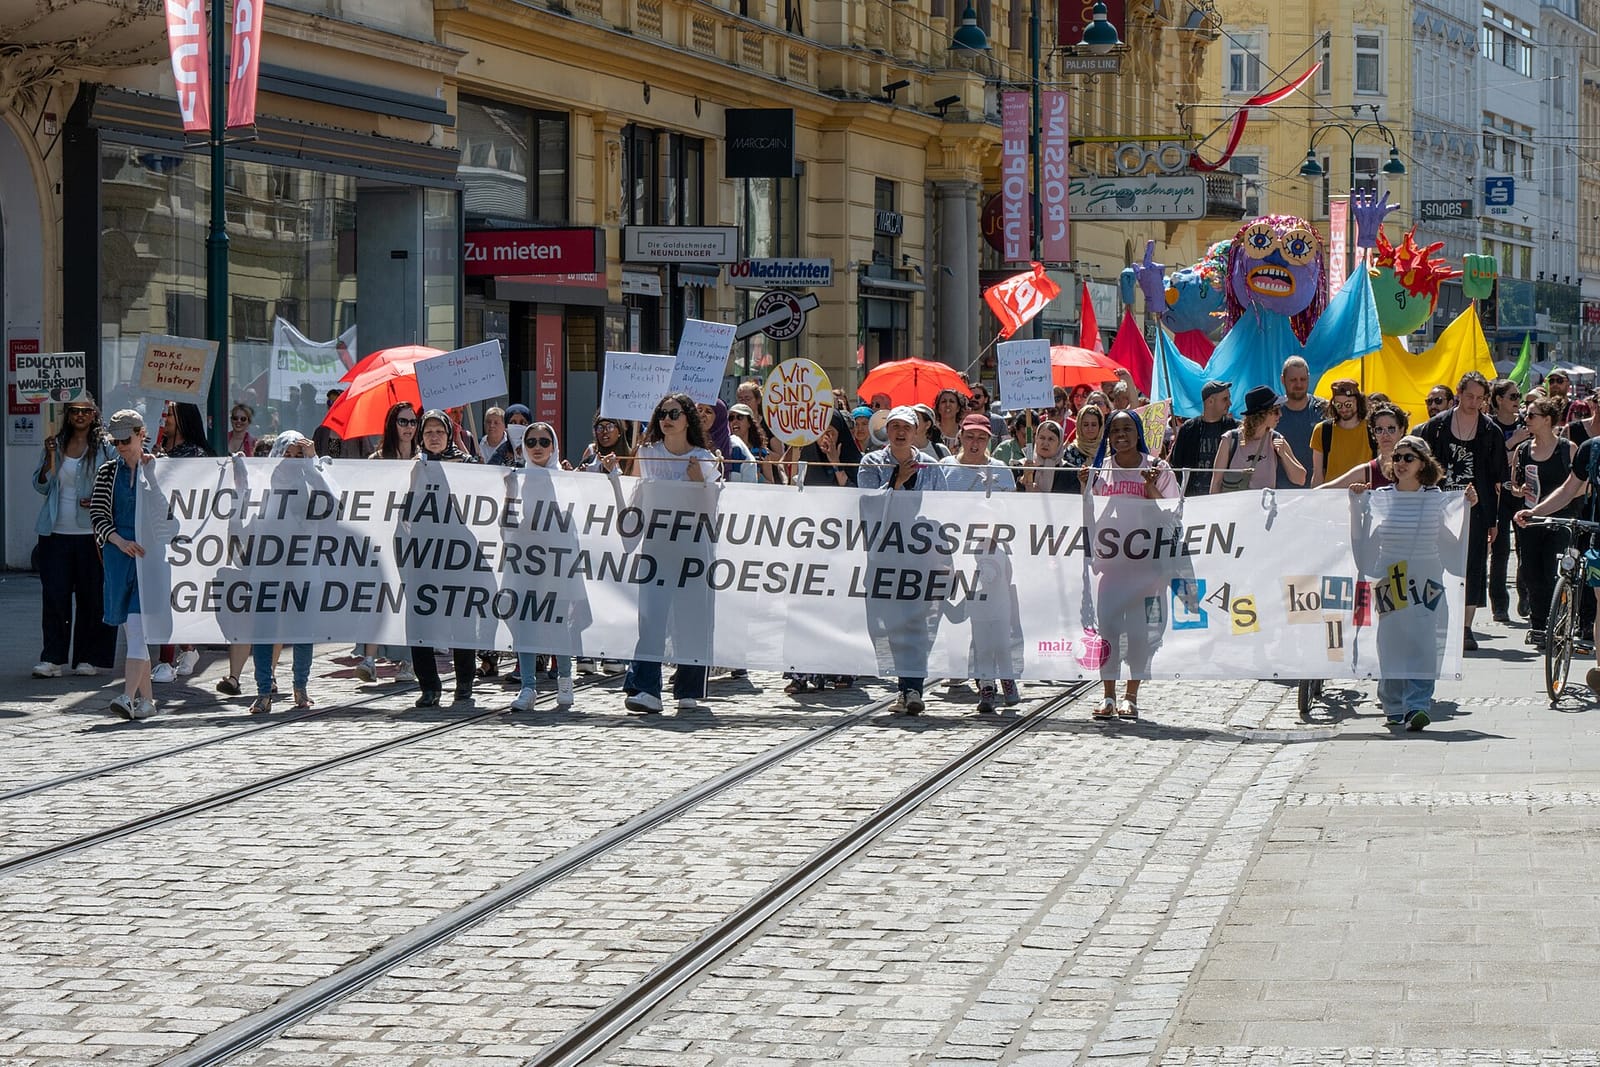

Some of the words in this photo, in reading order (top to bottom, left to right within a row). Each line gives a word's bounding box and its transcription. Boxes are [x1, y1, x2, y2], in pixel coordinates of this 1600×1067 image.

[1066, 60, 1096, 69] PALAIS
[1097, 60, 1116, 68] LINZ
[1070, 205, 1195, 213] UGENOPTIK
[464, 243, 487, 261] Zu
[493, 242, 562, 261] mieten
[759, 294, 792, 315] TABAK
[769, 312, 801, 337] TRAFIK
[17, 356, 84, 369] EDUCATION
[153, 350, 182, 359] make
[38, 369, 50, 379] IS
[53, 369, 61, 378] A
[156, 373, 195, 389] history
[167, 488, 298, 521] NICHT
[305, 490, 375, 521] DIE
[384, 484, 522, 528] HÄNDE
[530, 500, 575, 533] IN
[582, 503, 1016, 555] HOFFNUNGSWASSER
[1029, 522, 1245, 559] WASCHEN,
[168, 534, 382, 567] SONDERN:
[392, 537, 665, 587] WIDERSTAND.
[677, 557, 835, 597] POESIE.
[848, 566, 988, 602] LEBEN.
[171, 580, 311, 613] GEGEN
[319, 581, 406, 613] DEN
[413, 583, 564, 624] STROM.
[1038, 638, 1073, 652] maiz
